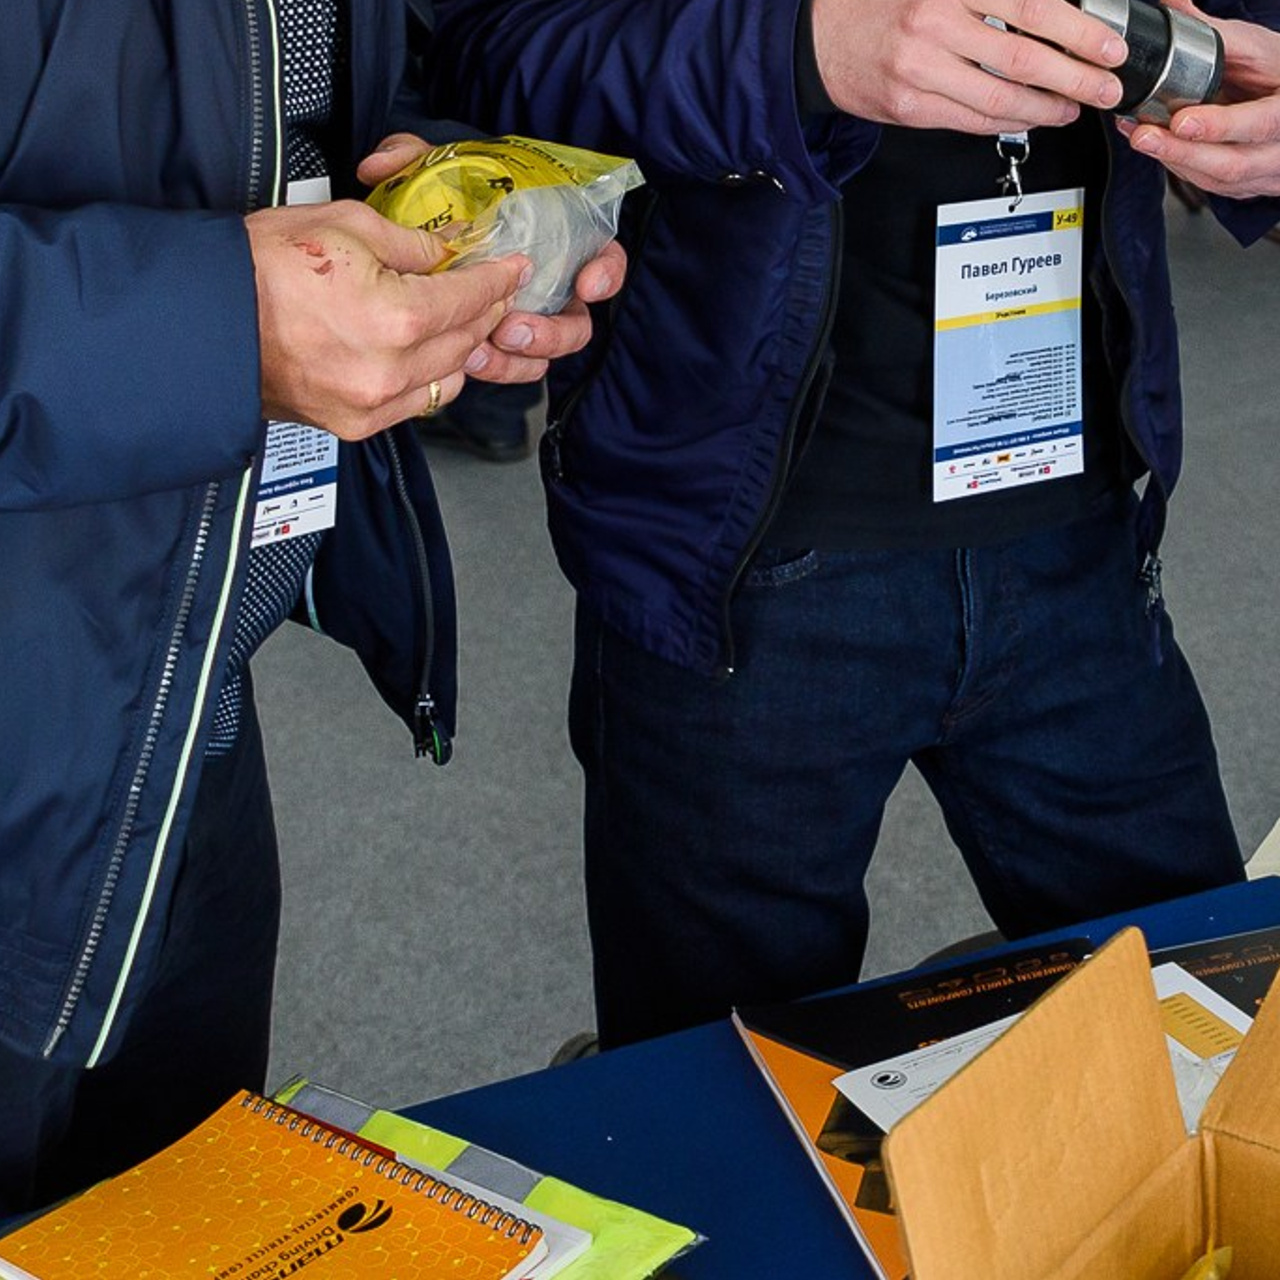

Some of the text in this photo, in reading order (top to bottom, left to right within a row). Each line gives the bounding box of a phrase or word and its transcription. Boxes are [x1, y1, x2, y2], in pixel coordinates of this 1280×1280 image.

[961, 253, 1062, 279] Павел Гуреев
[985, 284, 1038, 301] Березовский
[976, 977, 1015, 993] VEHICLE
[907, 987, 973, 1010] COMPONENTS
[291, 1185, 360, 1235] COMMERCIAL
[244, 1234, 292, 1264] VEHICLE
[277, 1226, 336, 1262] Driving
